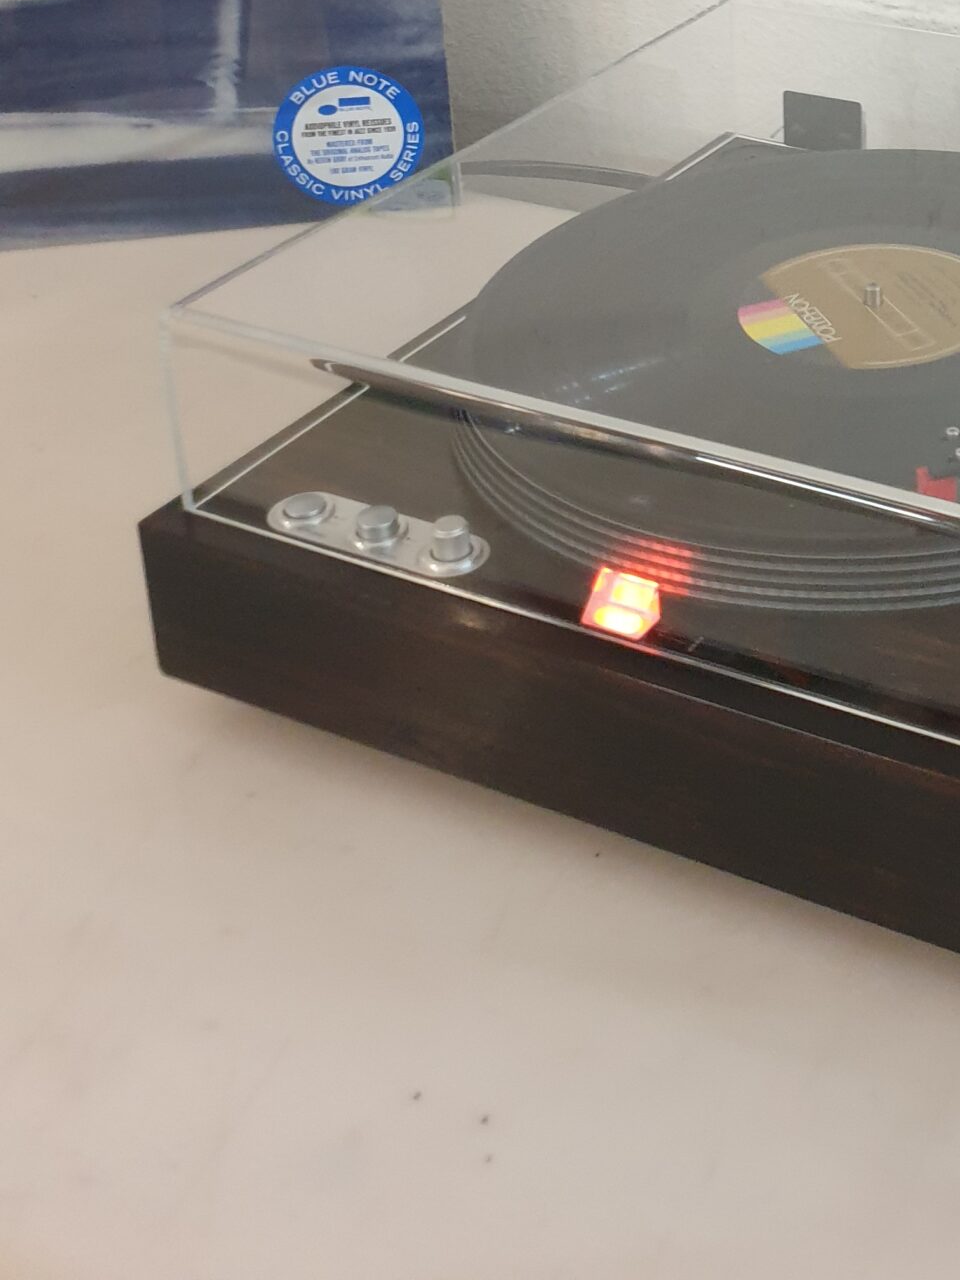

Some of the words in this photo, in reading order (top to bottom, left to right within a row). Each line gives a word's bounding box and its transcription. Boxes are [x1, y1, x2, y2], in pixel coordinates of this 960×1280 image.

[289, 71, 341, 105] BLUE
[348, 71, 401, 100] NOTE
[276, 131, 326, 195] CLASSIC
[331, 183, 390, 201] VINYL
[390, 121, 420, 182] SERIES
